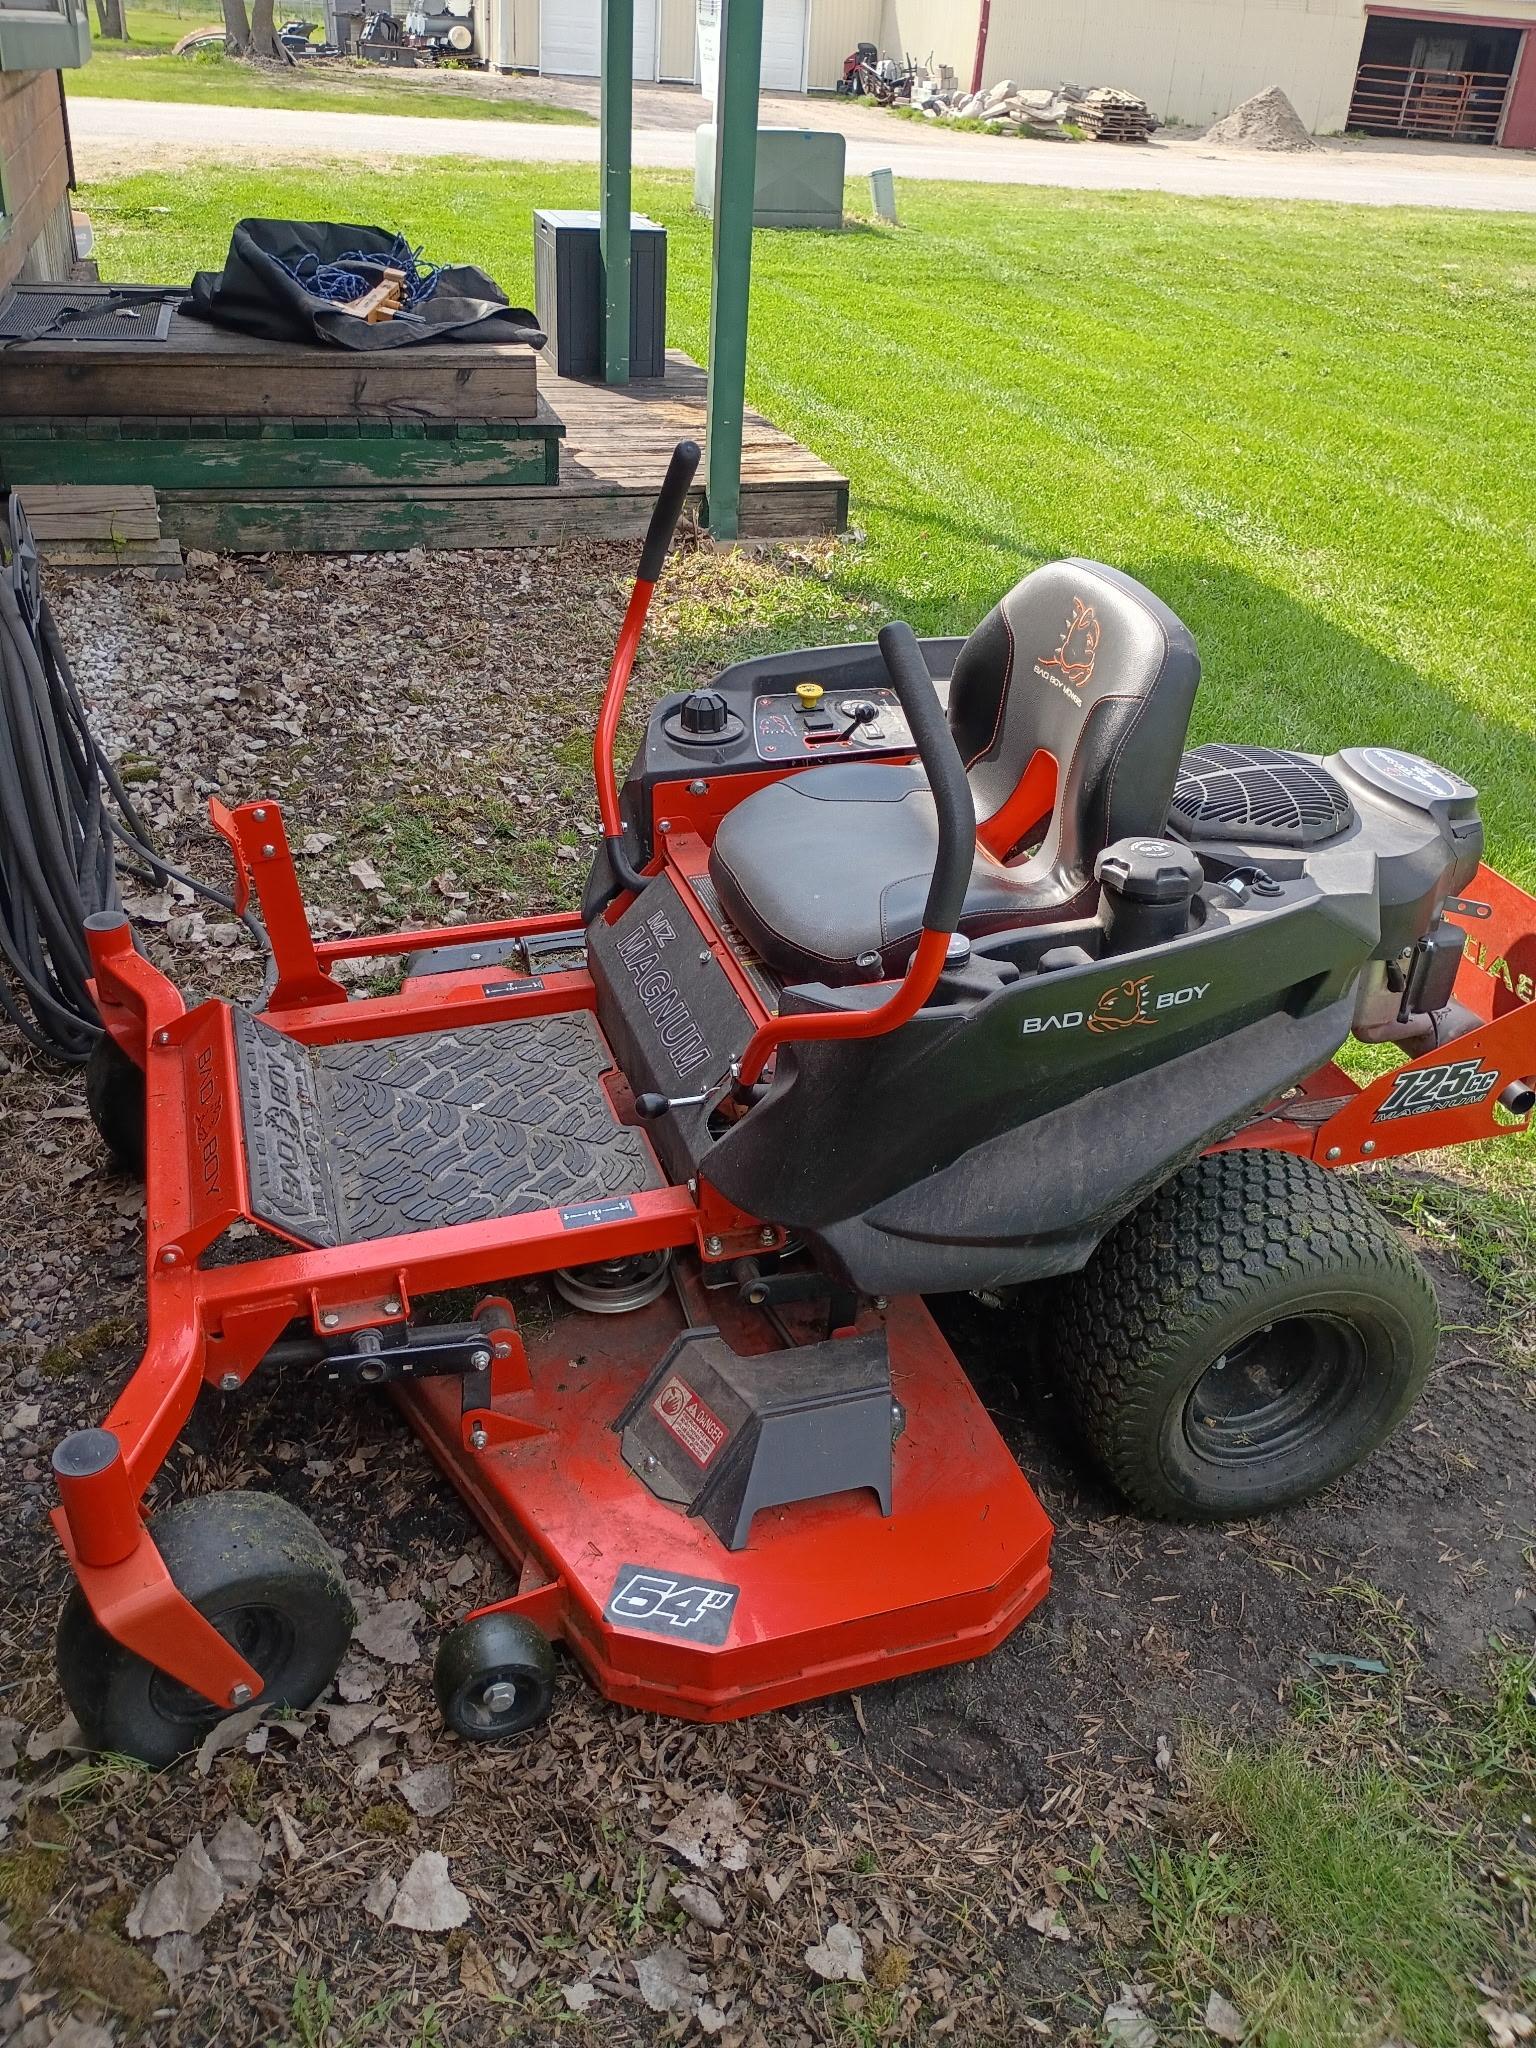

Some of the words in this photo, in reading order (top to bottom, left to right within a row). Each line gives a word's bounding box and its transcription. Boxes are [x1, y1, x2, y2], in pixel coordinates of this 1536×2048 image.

[647, 909, 677, 949] MZ
[616, 925, 712, 1079] MAGNUM
[1023, 1011, 1083, 1034] BAD
[1156, 983, 1211, 1010] BOY
[198, 1046, 214, 1106] BAD
[266, 1052, 291, 1108] BOY
[1373, 1093, 1488, 1123] MAGNUM
[203, 1136, 220, 1197] BOY
[276, 1138, 303, 1201] BAD
[695, 1410, 724, 1445] DANGER
